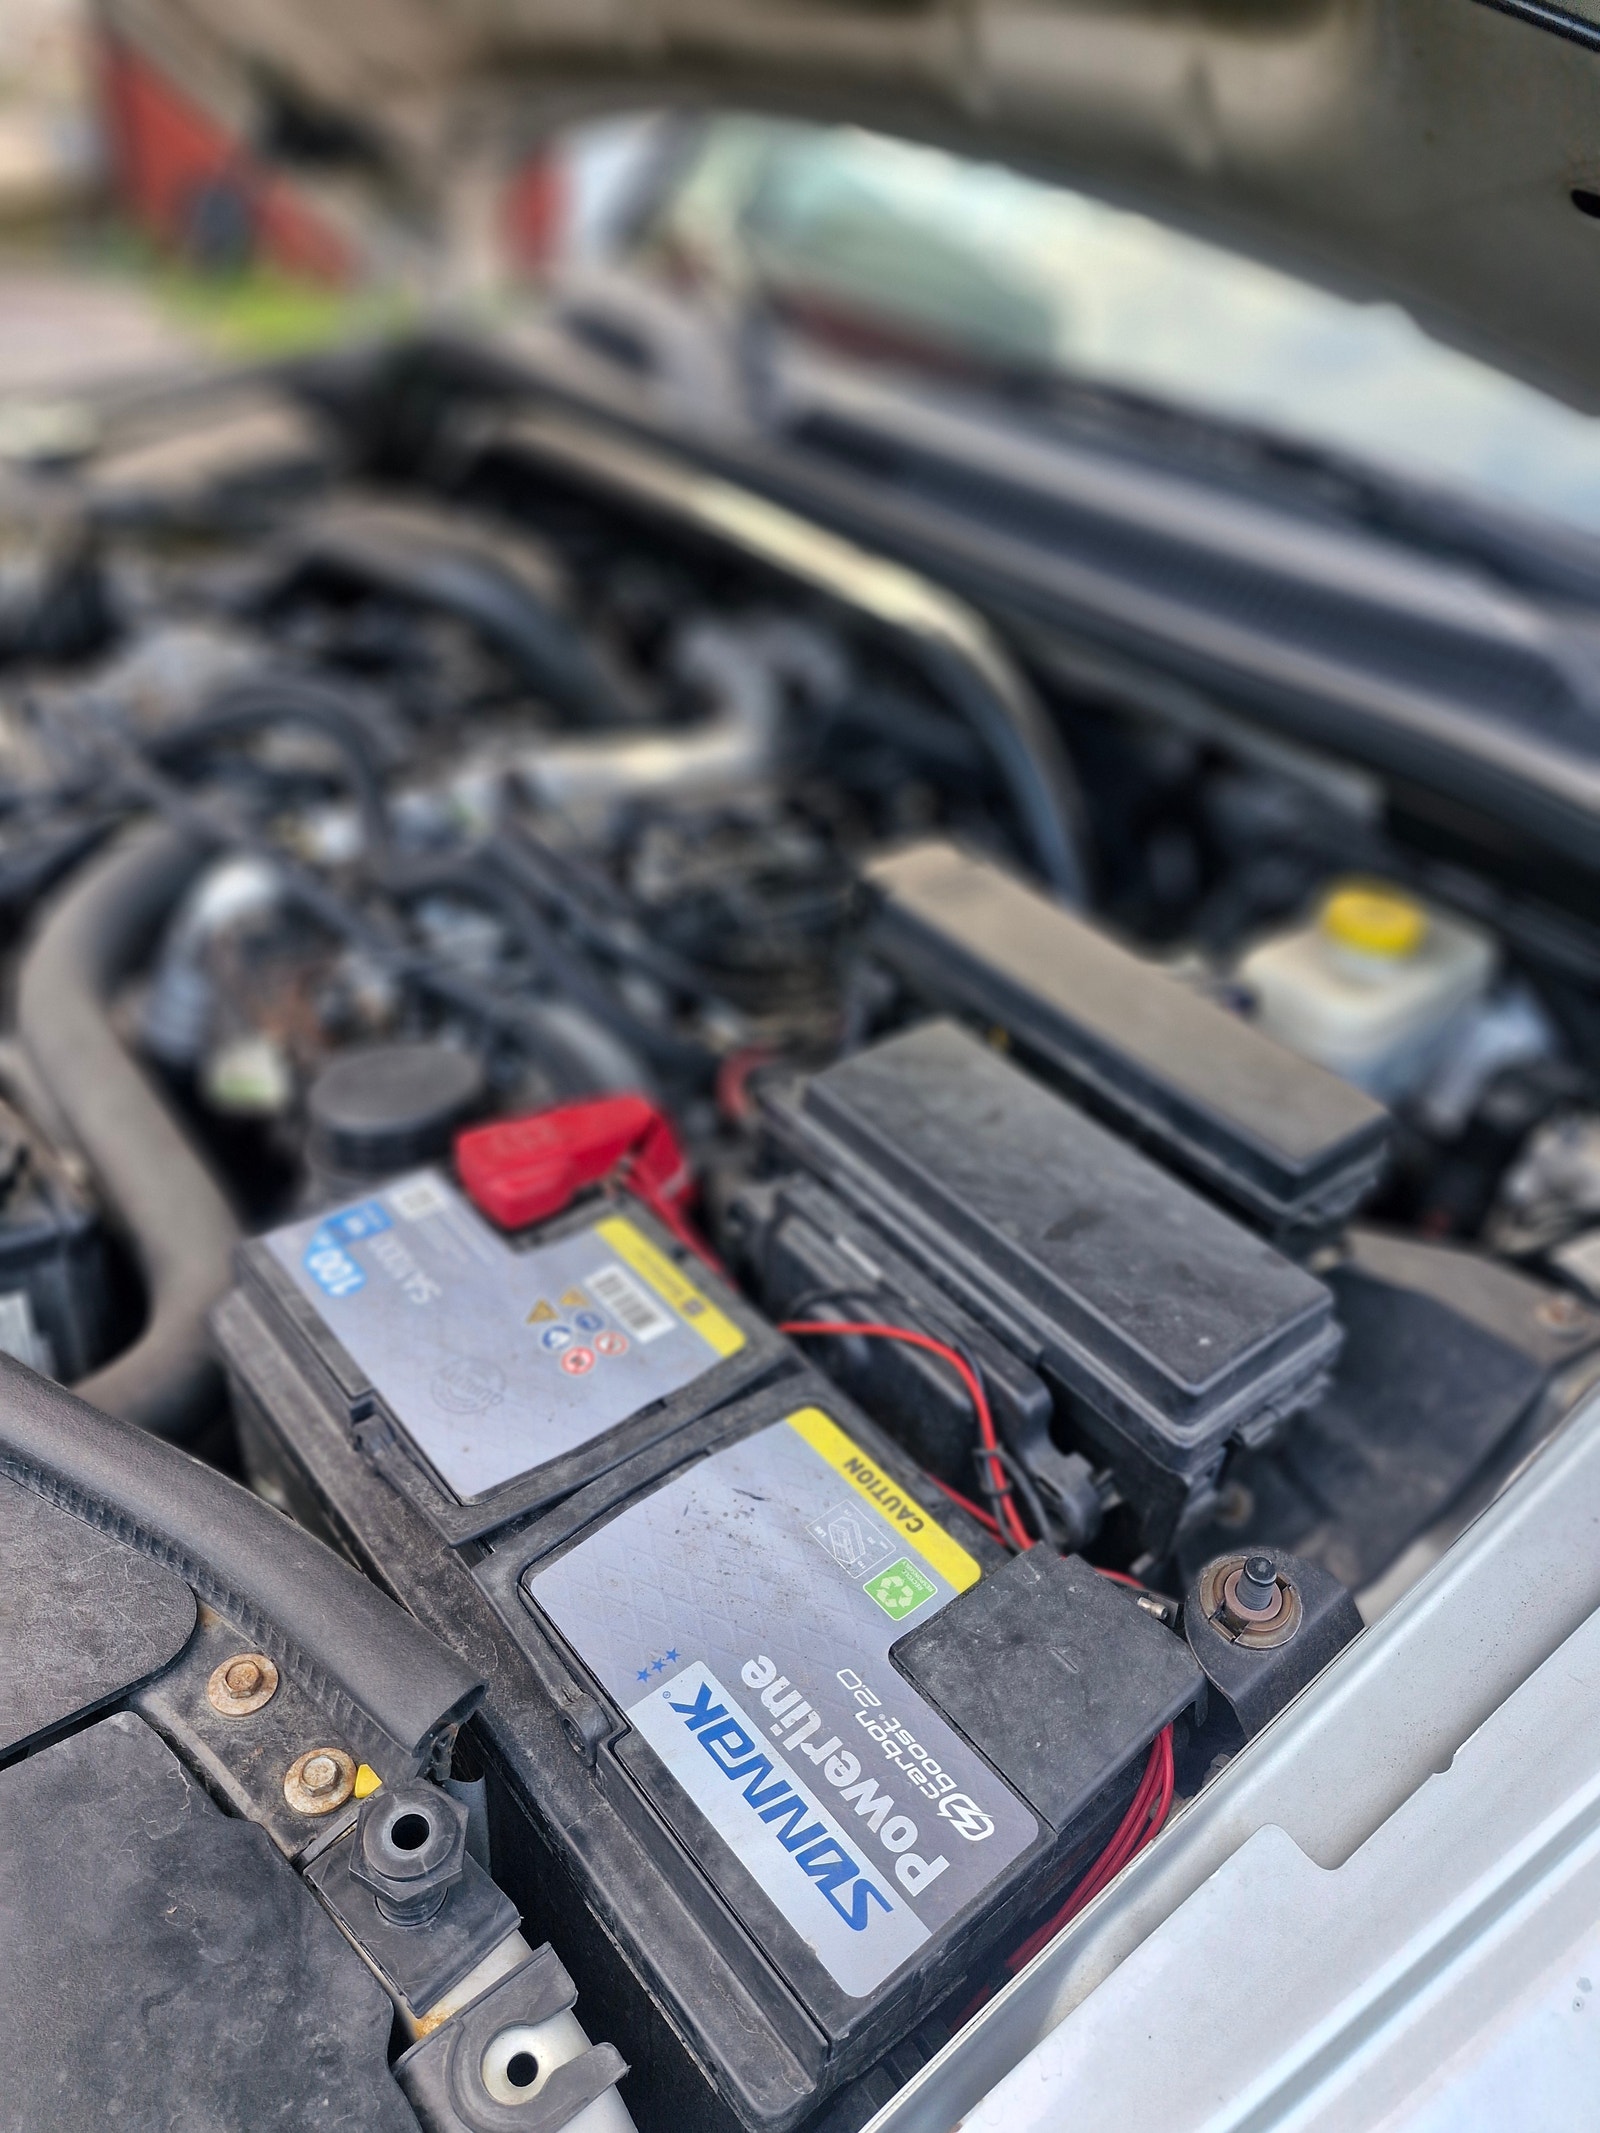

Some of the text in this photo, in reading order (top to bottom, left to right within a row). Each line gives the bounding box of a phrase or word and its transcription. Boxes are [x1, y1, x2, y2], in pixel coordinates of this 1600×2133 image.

[309, 1249, 362, 1295] 100
[844, 1457, 924, 1533] CAUTION
[900, 1567, 924, 1591] RECYCLE
[901, 1559, 934, 1593] RESPONSIBLY
[836, 1668, 882, 1708] 2.0
[741, 1655, 950, 1897] Powerline
[855, 1710, 940, 1800] carbon
